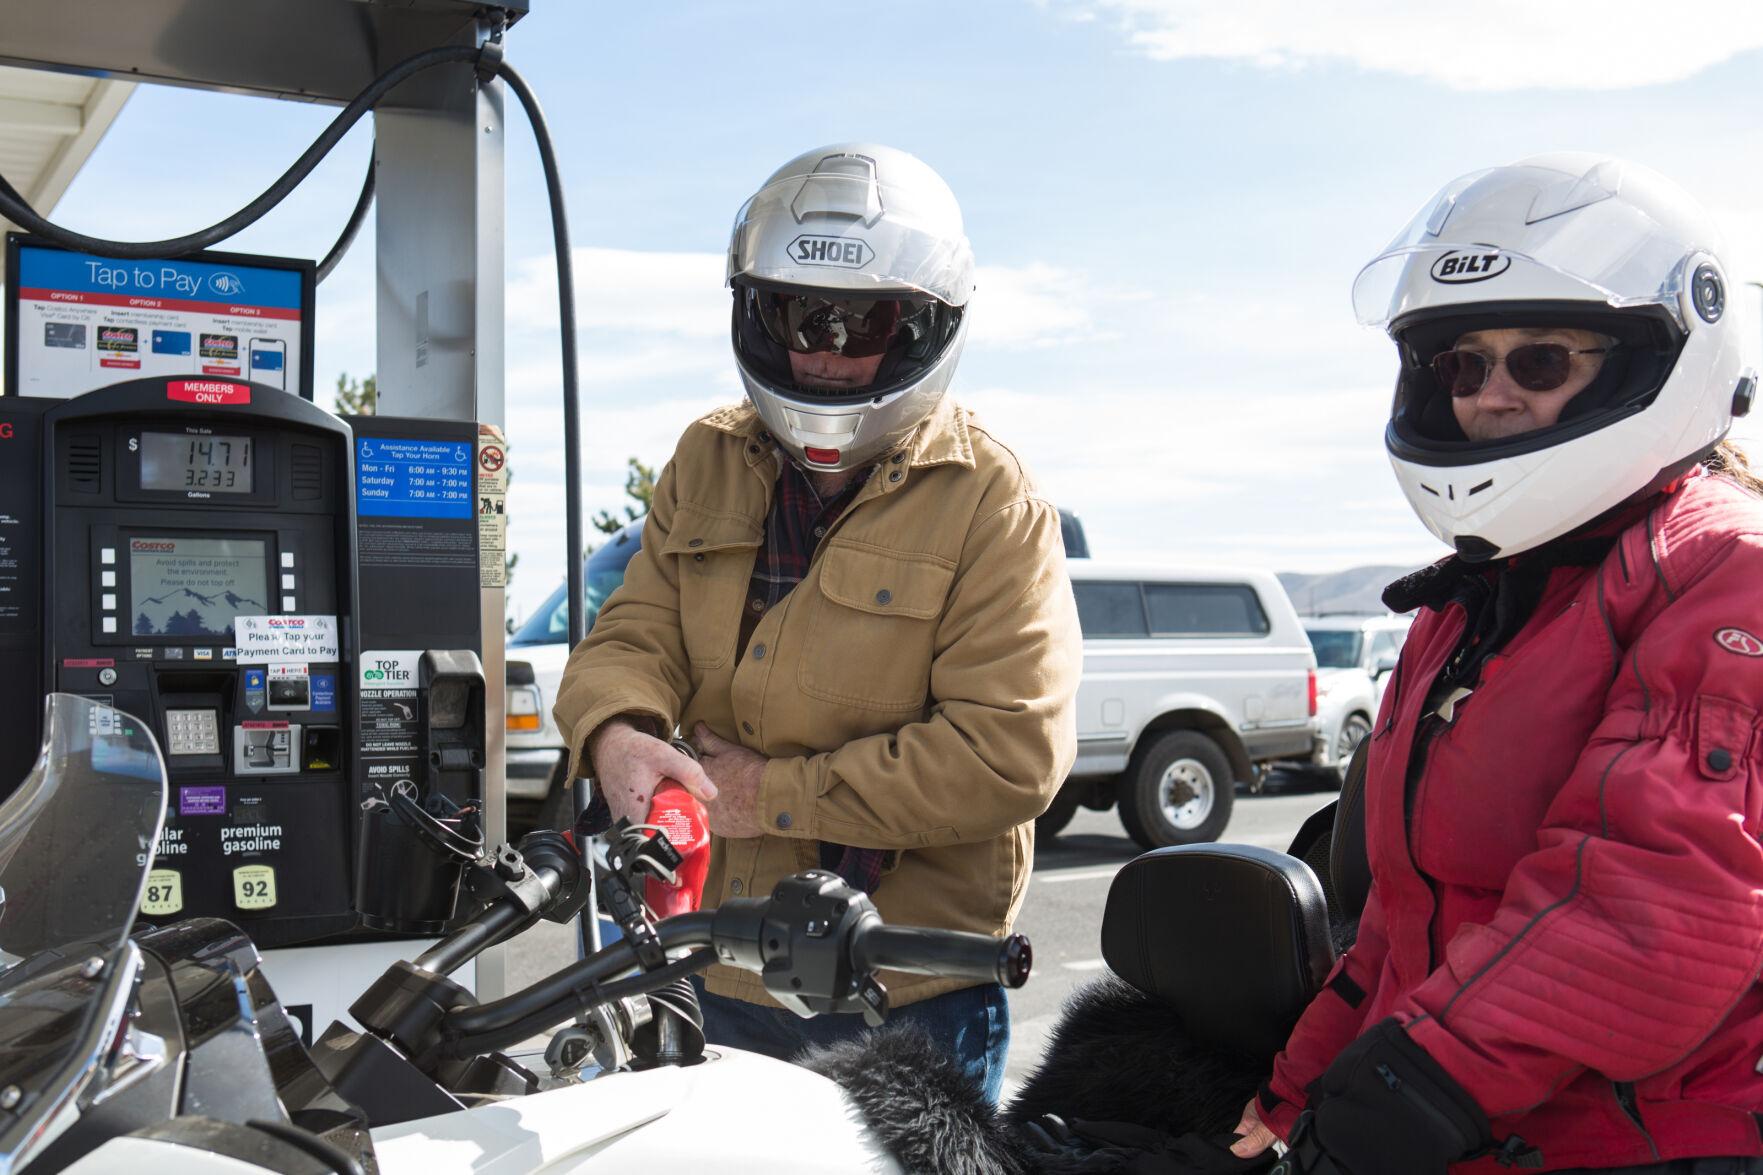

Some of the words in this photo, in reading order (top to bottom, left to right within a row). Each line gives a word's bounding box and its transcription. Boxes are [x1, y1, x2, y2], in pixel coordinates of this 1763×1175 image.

[797, 240, 863, 264] SHOEI
[85, 261, 128, 290] Tap
[133, 267, 155, 288] to
[160, 268, 202, 297] Pay
[50, 292, 79, 300] OPTION
[129, 298, 156, 307] OPTION
[230, 306, 255, 315] OPTION
[184, 382, 234, 394] MEMBERS
[195, 392, 223, 403] ONLY
[128, 437, 138, 451] $
[380, 443, 418, 452] Assistance
[420, 445, 451, 454] Available
[188, 441, 249, 467] 14.71
[391, 451, 404, 460] Tap
[361, 464, 378, 472] Mon
[384, 464, 395, 473] Fri
[408, 466, 425, 474] 6:00
[441, 467, 457, 475] 9:30
[185, 469, 235, 487] 3.233
[361, 476, 395, 486] Saturday
[409, 477, 425, 486] 7:00
[442, 479, 458, 487] 7:00
[187, 491, 211, 499] Gallons
[361, 488, 390, 498] Sunday
[409, 489, 425, 498] 7:00
[442, 490, 458, 499] 7:00
[156, 558, 176, 567] Avoid
[178, 559, 197, 568] spills
[198, 559, 212, 567] and
[213, 560, 240, 568] protect
[160, 578, 185, 586] Please
[210, 579, 223, 588] top
[284, 632, 300, 642] Tap
[303, 633, 325, 642] your
[237, 647, 279, 658] Payment
[282, 646, 305, 655] Card
[307, 647, 317, 655] to
[319, 646, 337, 656] Pay
[376, 660, 399, 670] TOP
[385, 671, 409, 680] TIER
[369, 765, 387, 773] AVOID
[389, 765, 409, 773] SPILLS
[221, 823, 282, 841] premium
[223, 836, 281, 855] gasoline
[148, 885, 173, 902] 87
[242, 881, 268, 897] 92
